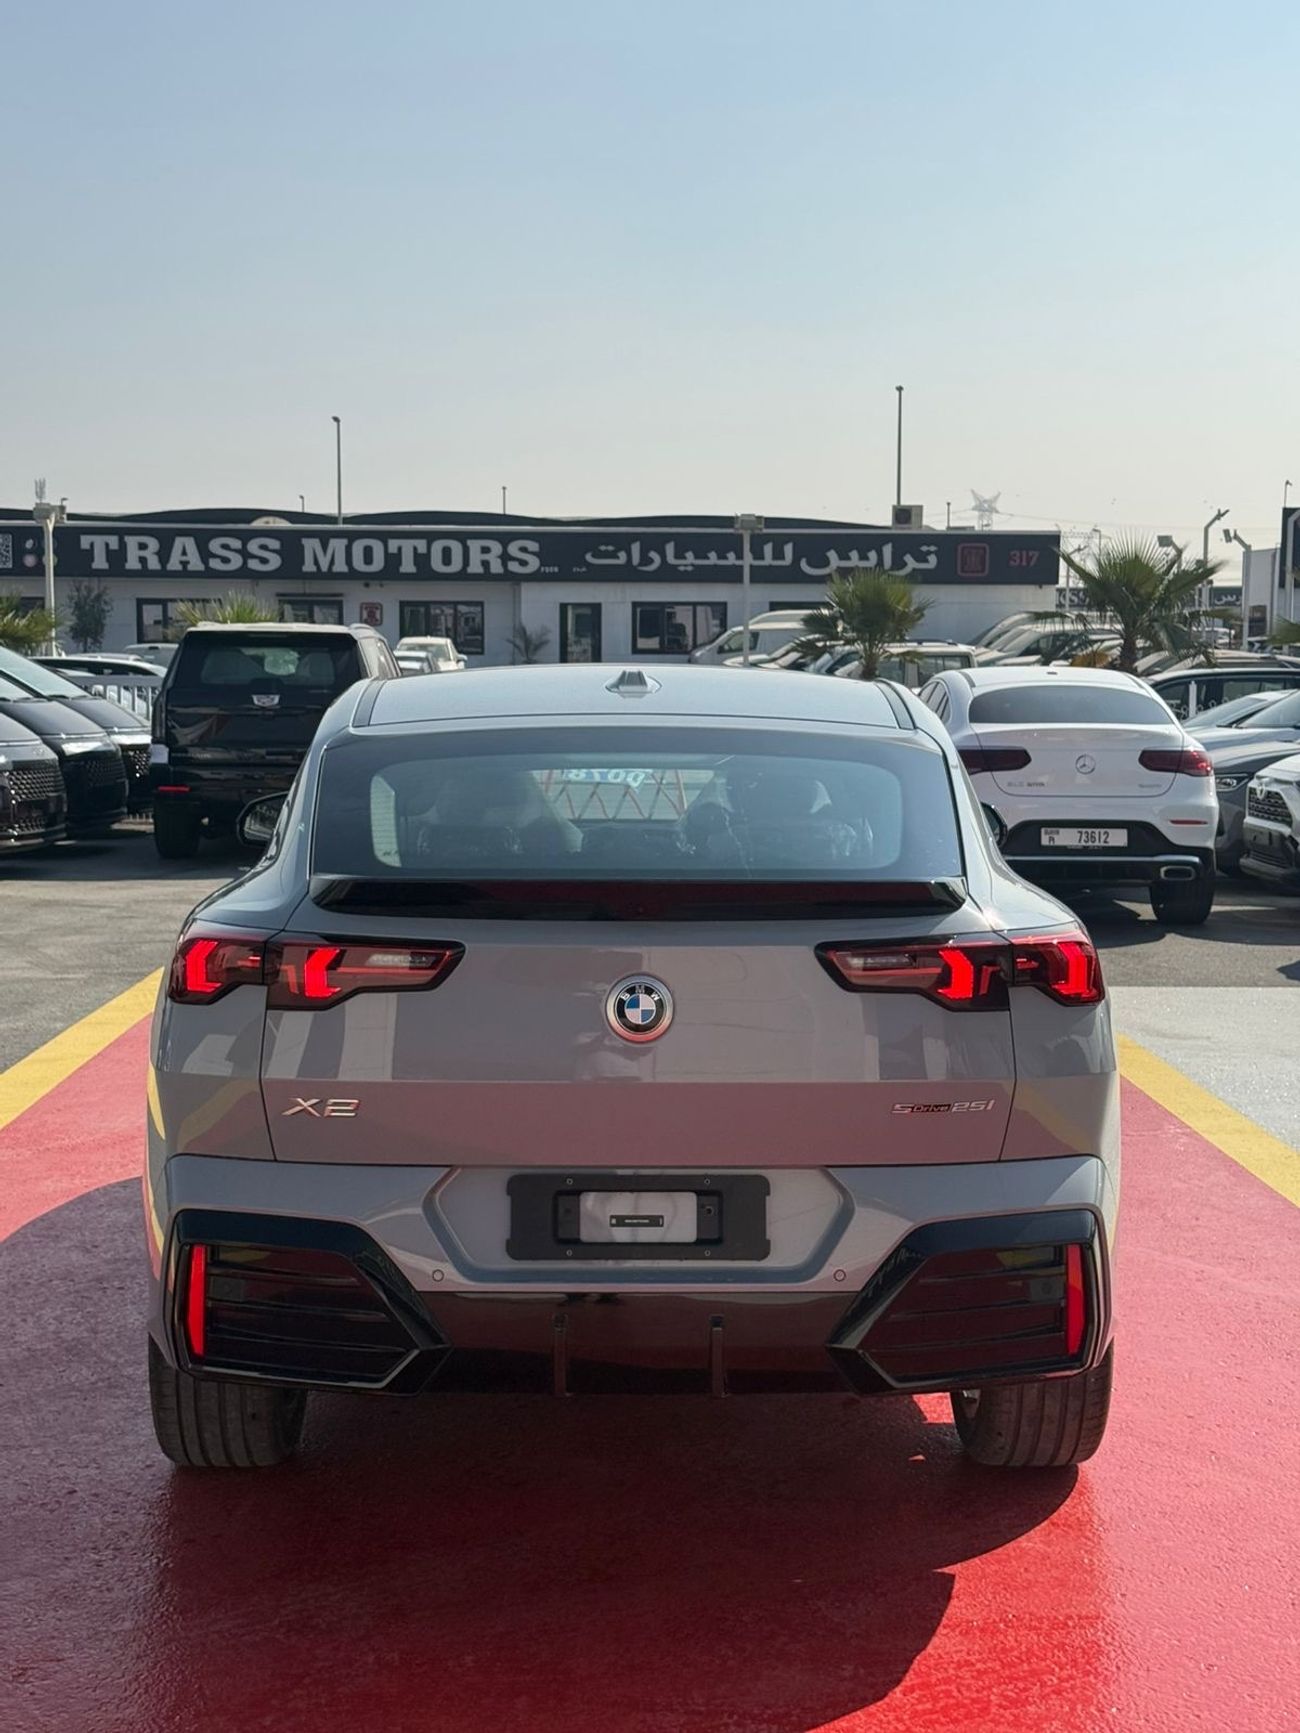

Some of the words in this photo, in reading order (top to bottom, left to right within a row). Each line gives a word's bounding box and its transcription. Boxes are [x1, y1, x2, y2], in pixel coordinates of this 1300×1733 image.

[80, 534, 283, 573] TRASS
[301, 537, 541, 575] MOTORS
[584, 540, 794, 572] للسيارات
[800, 542, 939, 577] تراس
[1008, 549, 1040, 567] 317
[1077, 830, 1110, 844] 73612
[619, 984, 661, 1001] BMW
[281, 1097, 360, 1118] X2
